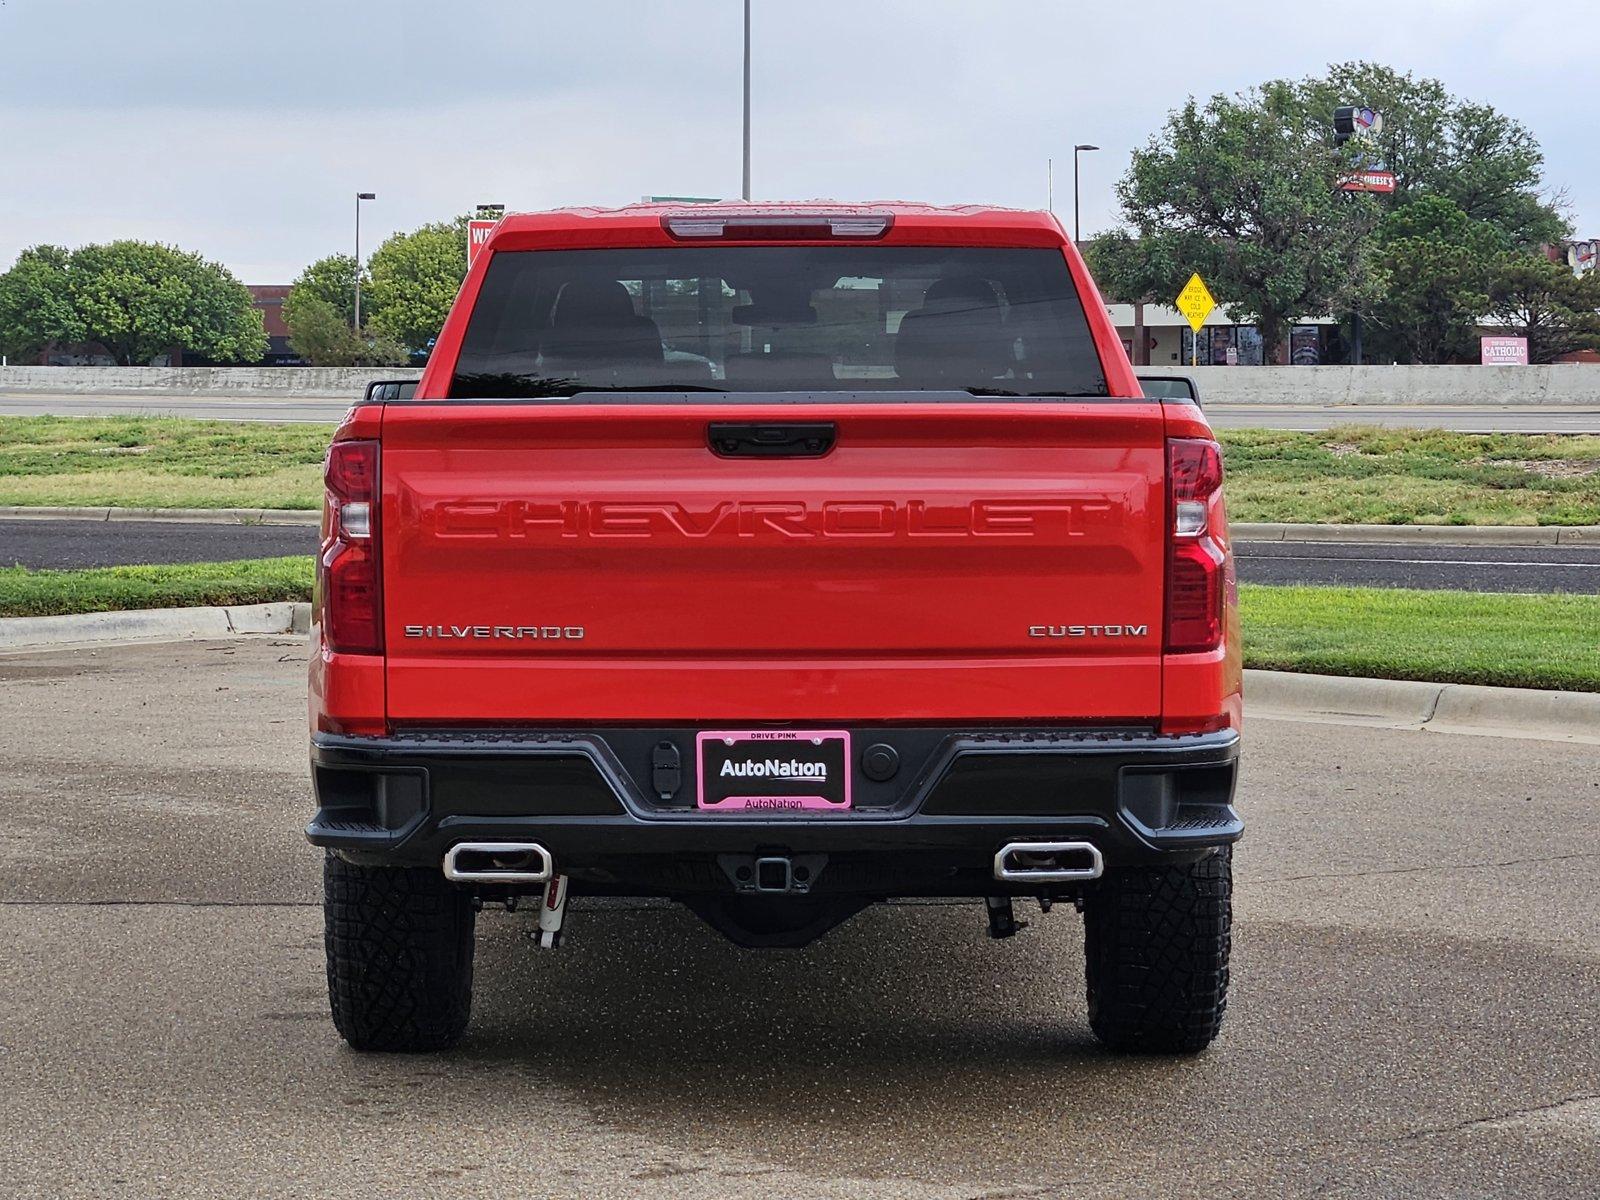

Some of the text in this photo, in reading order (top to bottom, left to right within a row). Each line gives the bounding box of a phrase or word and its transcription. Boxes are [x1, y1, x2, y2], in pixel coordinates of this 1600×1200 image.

[1484, 346, 1526, 357] CATHOLIC
[434, 499, 1112, 538] CHEVROLET
[404, 625, 585, 639] SILVERADO
[1028, 625, 1149, 637] CUSTOM
[750, 732, 798, 740] DRIVE PINK
[720, 759, 827, 777] AutoNation
[744, 798, 803, 809] AutoNation
